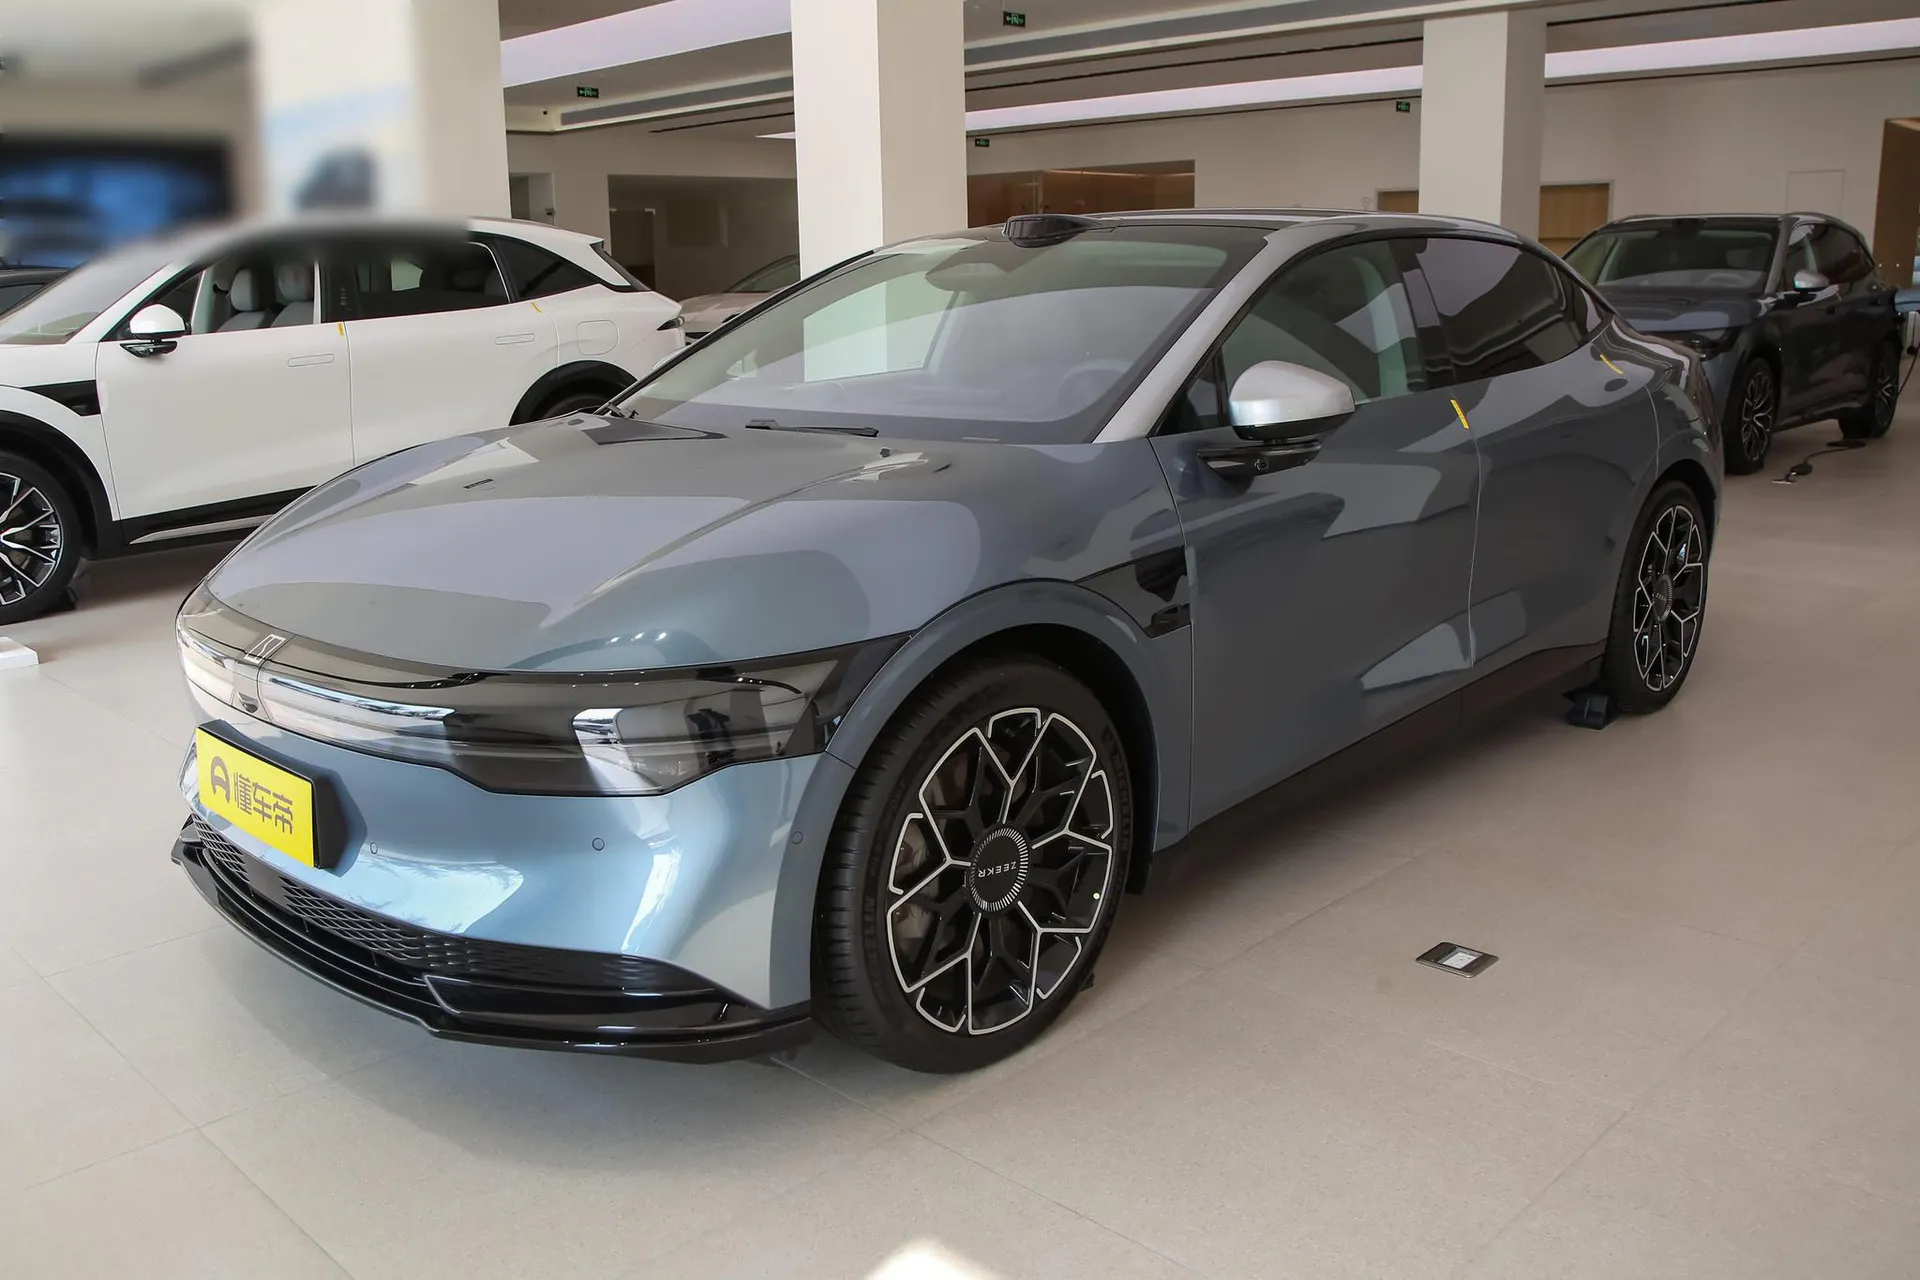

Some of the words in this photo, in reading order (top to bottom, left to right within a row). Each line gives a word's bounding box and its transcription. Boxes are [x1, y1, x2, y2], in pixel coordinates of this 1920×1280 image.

[234, 772, 293, 834] 懂车帝
[1110, 752, 1130, 851] MICHELIN
[978, 861, 1017, 878] ZEEKR
